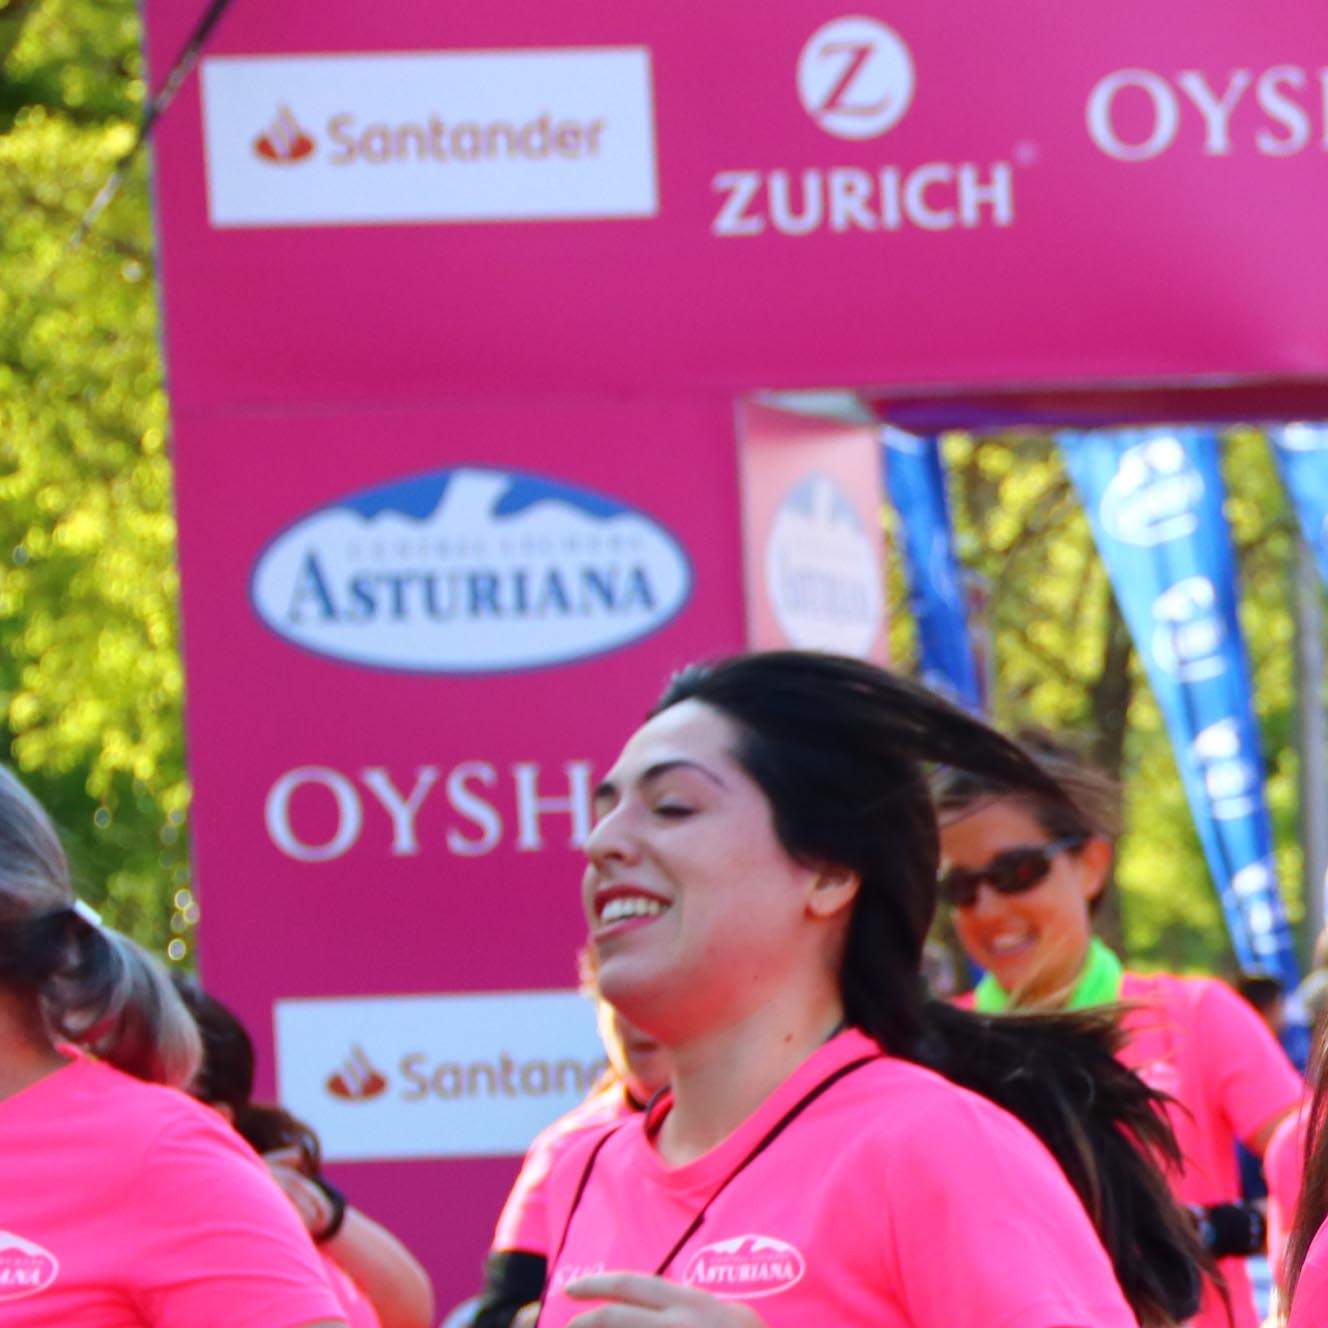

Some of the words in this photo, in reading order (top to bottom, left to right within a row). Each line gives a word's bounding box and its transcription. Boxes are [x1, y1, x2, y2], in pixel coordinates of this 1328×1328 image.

[326, 113, 604, 165] Santander
[712, 163, 1013, 237] ZURICH
[287, 548, 657, 627] ASTURIANA
[264, 760, 592, 863] OYSH
[400, 1050, 600, 1100] Santan
[690, 1259, 796, 1284] ASTURIANA
